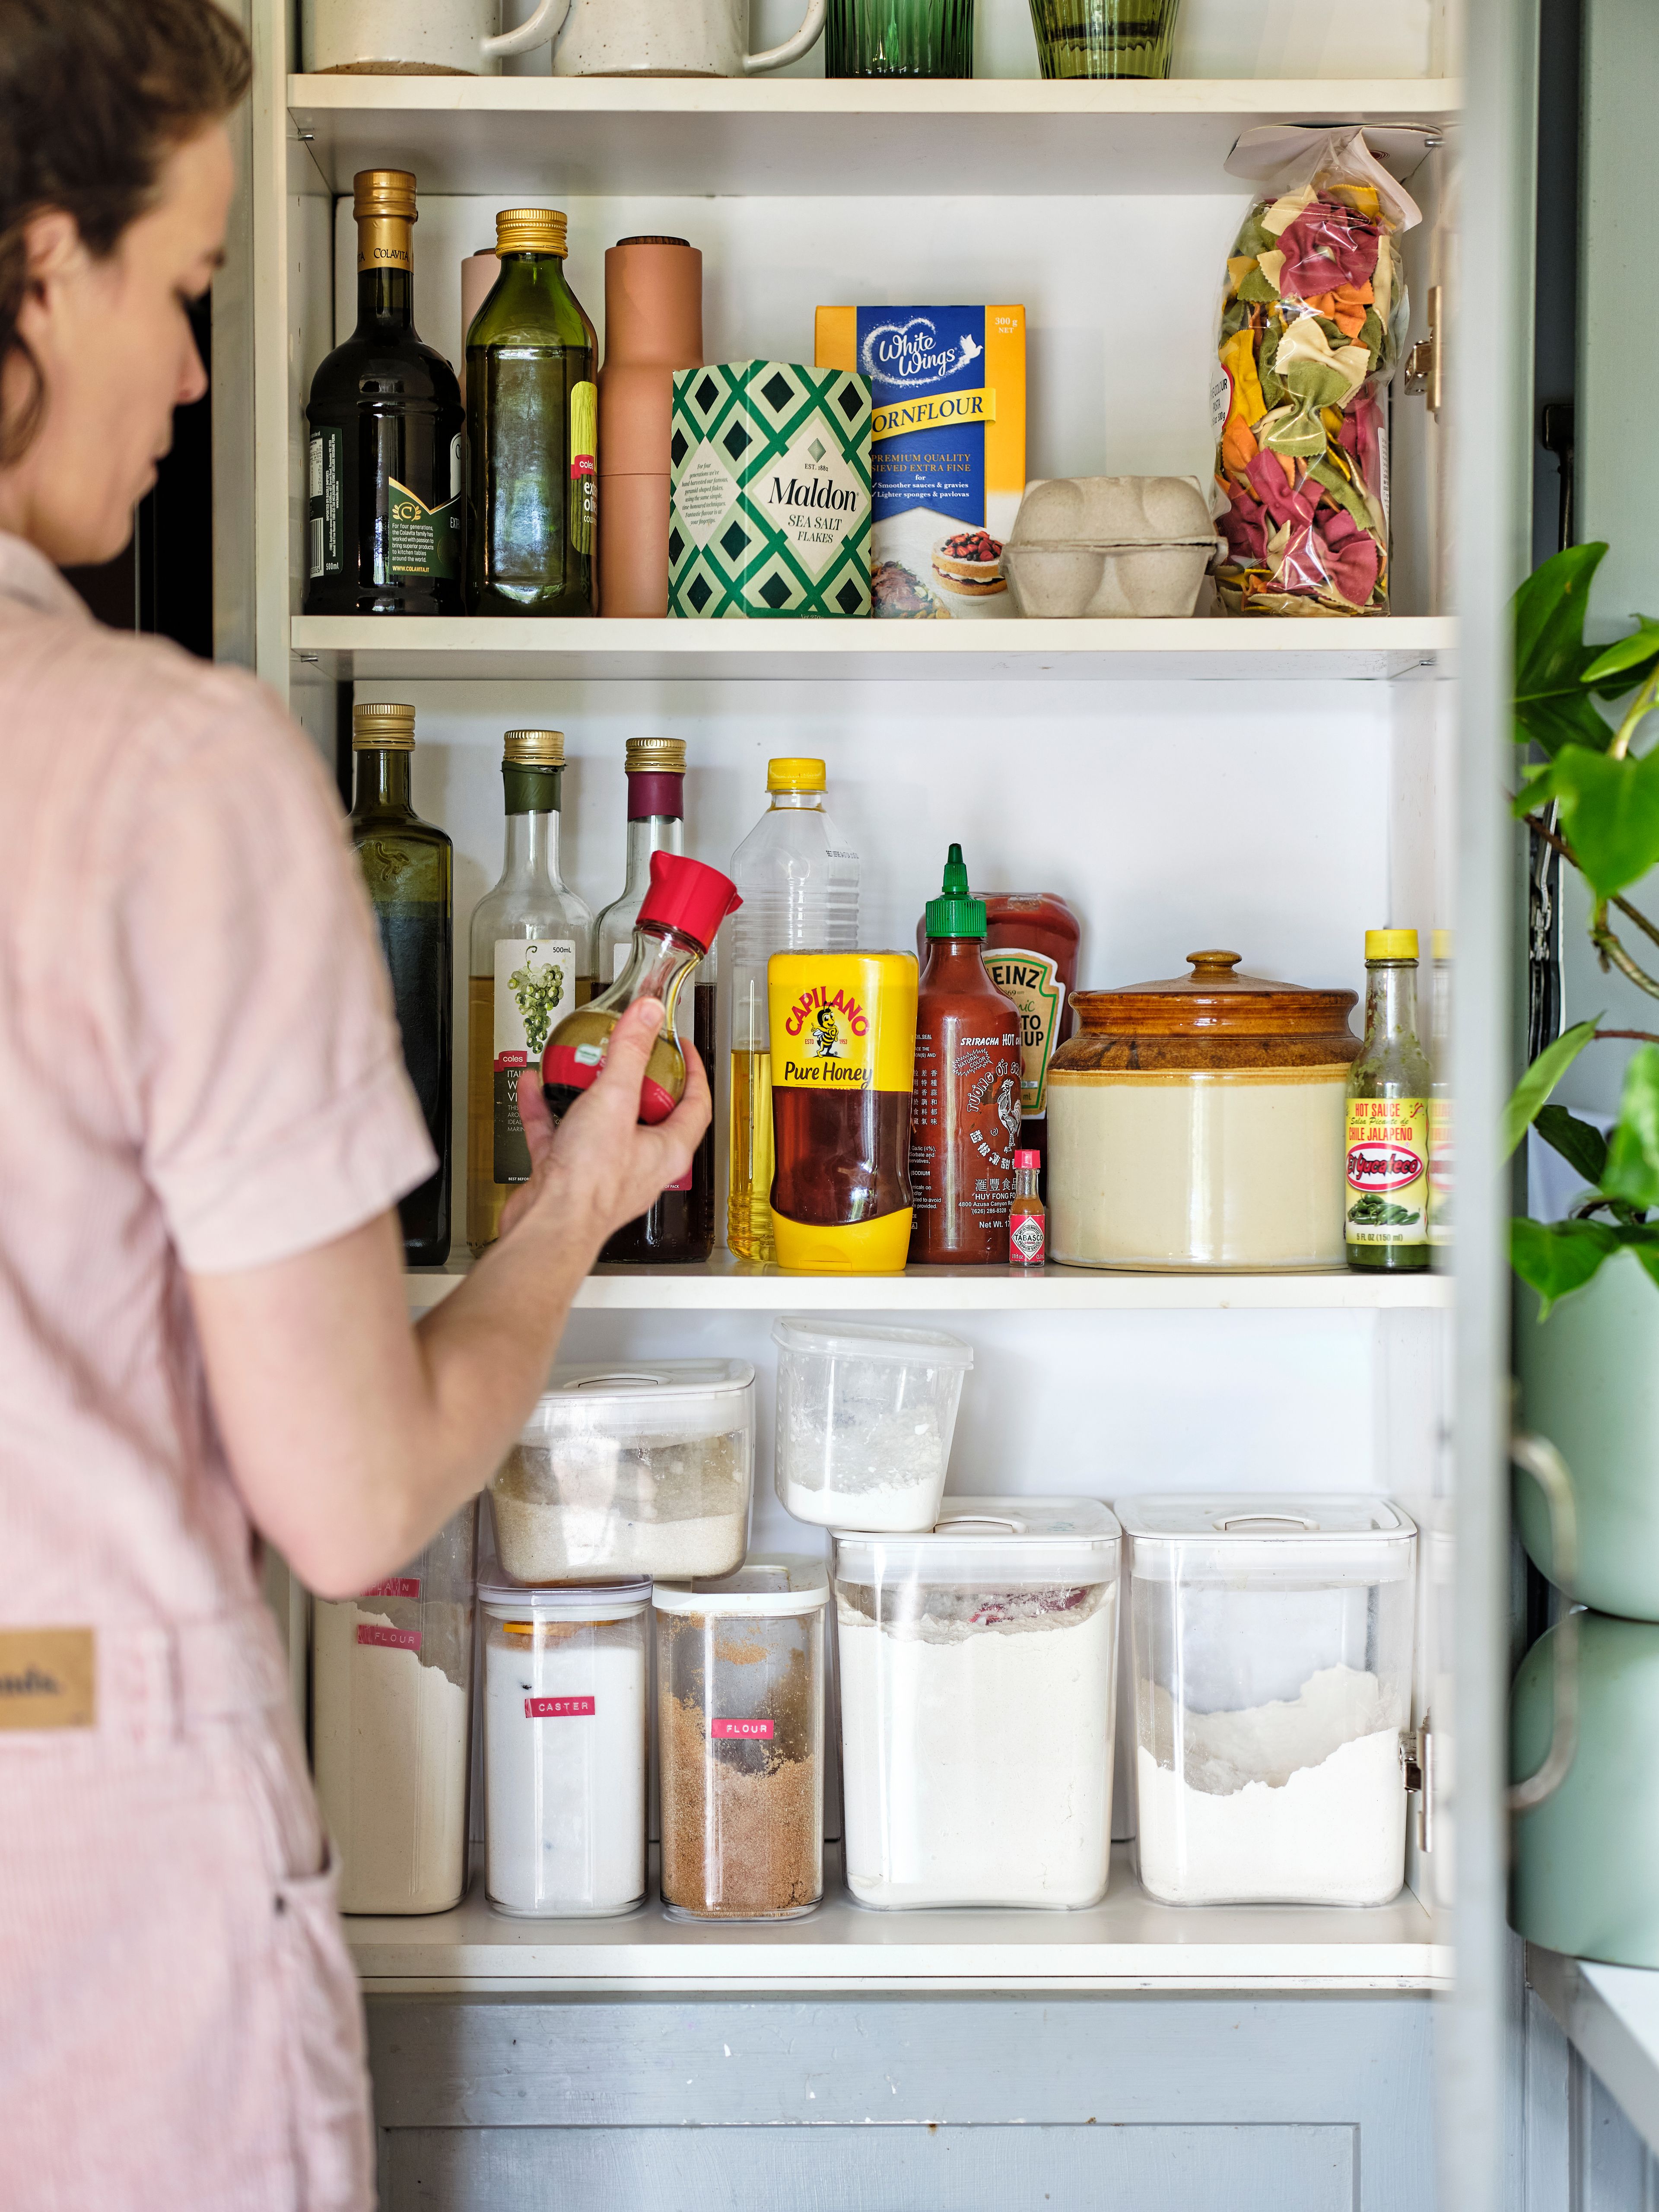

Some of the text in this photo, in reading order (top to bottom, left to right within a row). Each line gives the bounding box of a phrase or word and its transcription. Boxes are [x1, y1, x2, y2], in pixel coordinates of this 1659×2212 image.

[374, 248, 409, 262] COLAVITA
[879, 332, 936, 362] White
[899, 348, 956, 376] Wings
[872, 396, 983, 432] ORNFLOUR
[579, 461, 593, 469] coles
[924, 454, 971, 463] QUALITY
[768, 477, 856, 512] Maldon
[788, 514, 842, 531] SEA SALT
[798, 531, 833, 543] FLAKES
[992, 966, 1040, 989] EINZ
[785, 986, 870, 1036] CAPILANO
[960, 1037, 999, 1046] SRIRACHA
[1002, 1034, 1014, 1046] HOT
[958, 1054, 980, 1068] NATURAL
[970, 1056, 985, 1068] COLOR
[785, 1061, 873, 1090] Pure Honey
[1355, 1103, 1400, 1117] HOT SAUCE
[1349, 1125, 1412, 1141] CHILE JALAPEÑO
[1348, 1152, 1418, 1181] El Yucateco
[1019, 1241, 1040, 1250] PEPPER SAUCE
[375, 1633, 414, 1644] FLOUR
[539, 1703, 588, 1711] CASTER
[727, 1724, 767, 1733] FLOUR
